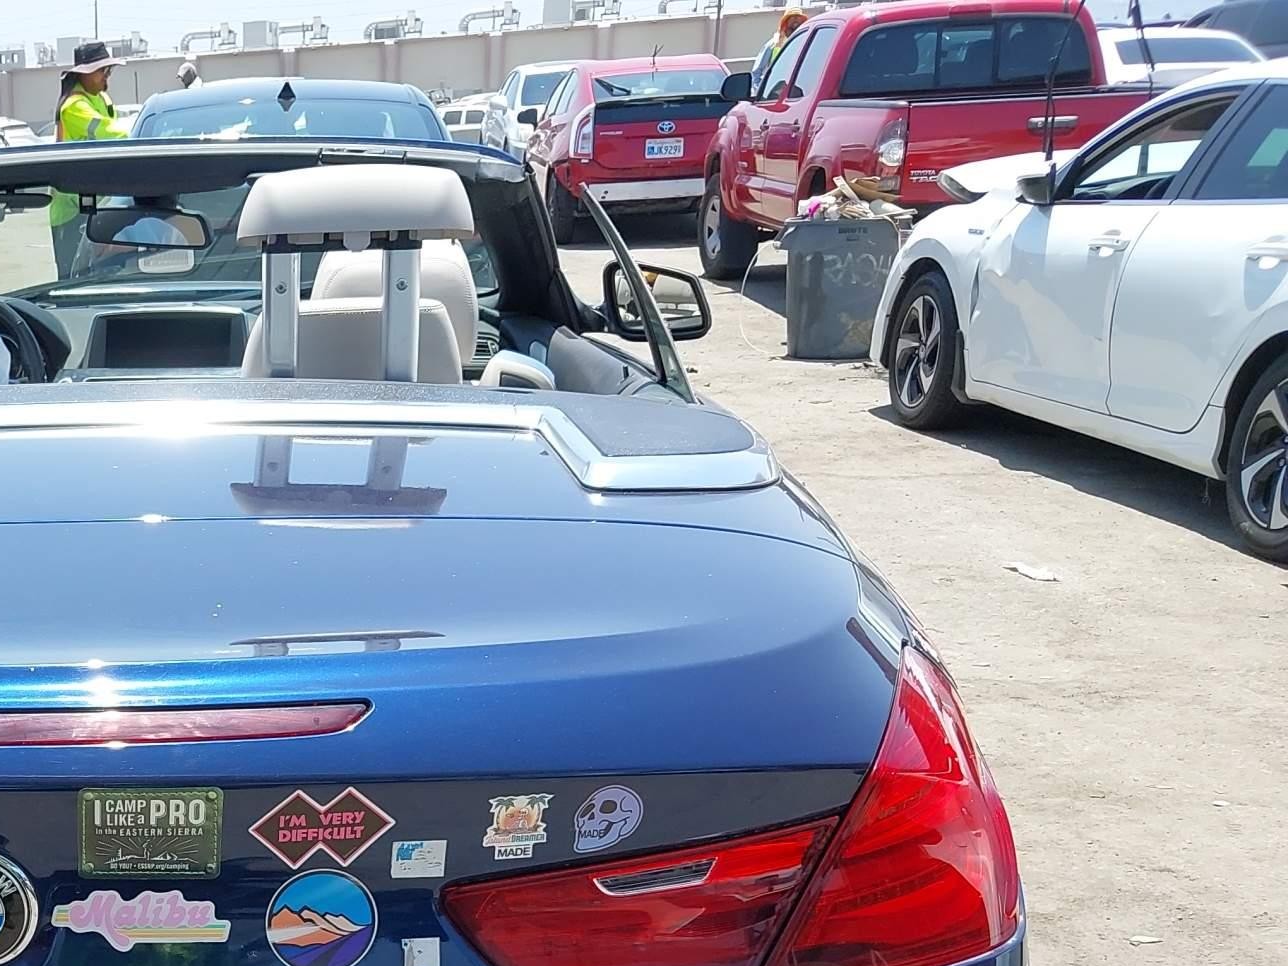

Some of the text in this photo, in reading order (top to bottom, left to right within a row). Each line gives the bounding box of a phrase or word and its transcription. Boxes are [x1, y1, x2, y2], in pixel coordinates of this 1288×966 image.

[94, 799, 102, 826] I
[105, 800, 147, 813] CAMP
[149, 799, 206, 826] PRO
[106, 813, 135, 826] LIKE
[279, 811, 365, 828] I'M VERY
[120, 828, 163, 837] EASTERN
[168, 828, 204, 836] SIERRA
[278, 826, 365, 843] DIFFICULT
[578, 829, 607, 840] MADE
[497, 846, 531, 858] MADE
[69, 894, 211, 947] Malibu
